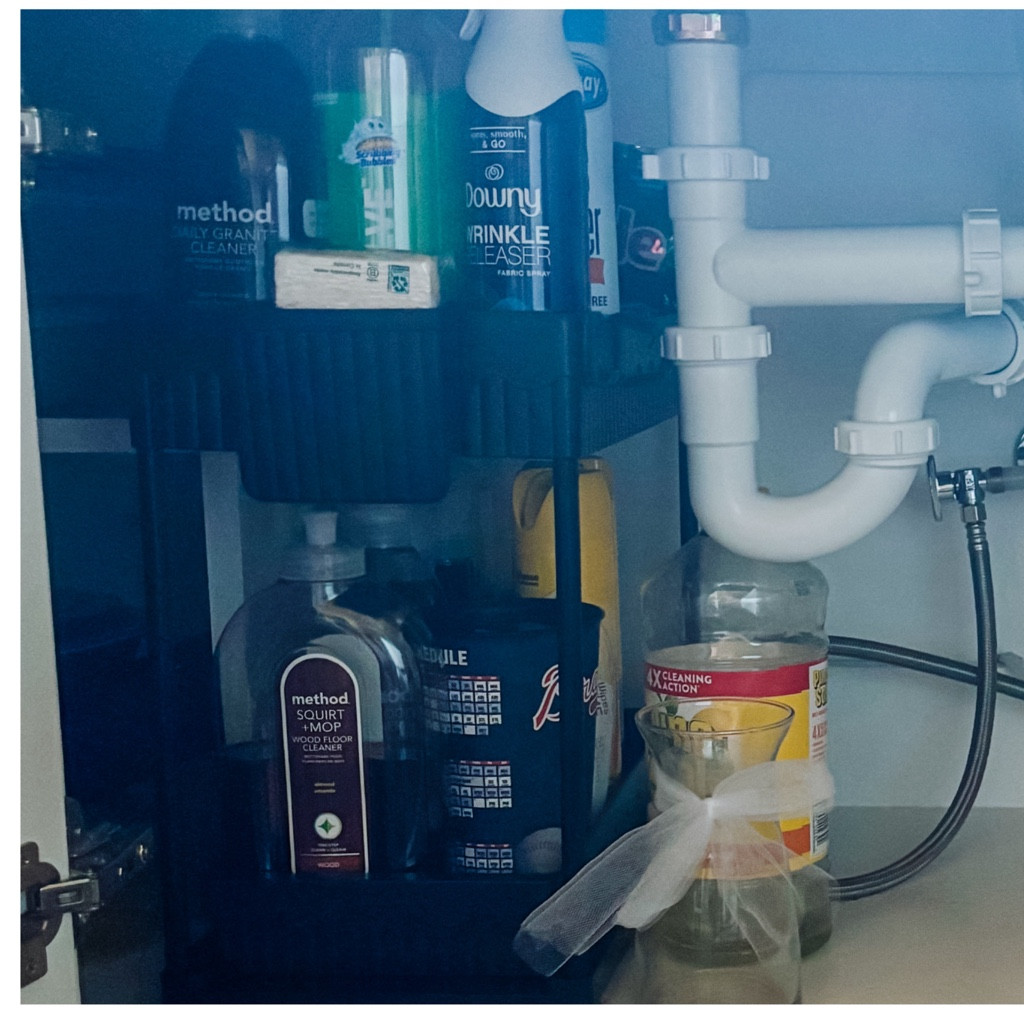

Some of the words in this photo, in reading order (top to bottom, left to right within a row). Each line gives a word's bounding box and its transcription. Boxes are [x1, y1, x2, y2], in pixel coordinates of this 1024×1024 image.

[490, 129, 527, 140] smooth,
[482, 141, 488, 149] &
[490, 140, 506, 149] GO
[466, 182, 542, 217] Downy
[178, 200, 271, 223] method
[191, 241, 257, 255] CLEANER
[468, 245, 551, 265] ELEASER
[591, 295, 608, 307] REE
[647, 668, 662, 689] 4X
[662, 672, 712, 685] CLEANING
[662, 683, 698, 694] ACTION
[292, 692, 350, 705] method
[297, 709, 345, 720] SQUIRT
[303, 722, 342, 733] +MOP
[323, 735, 353, 743] FLOOR
